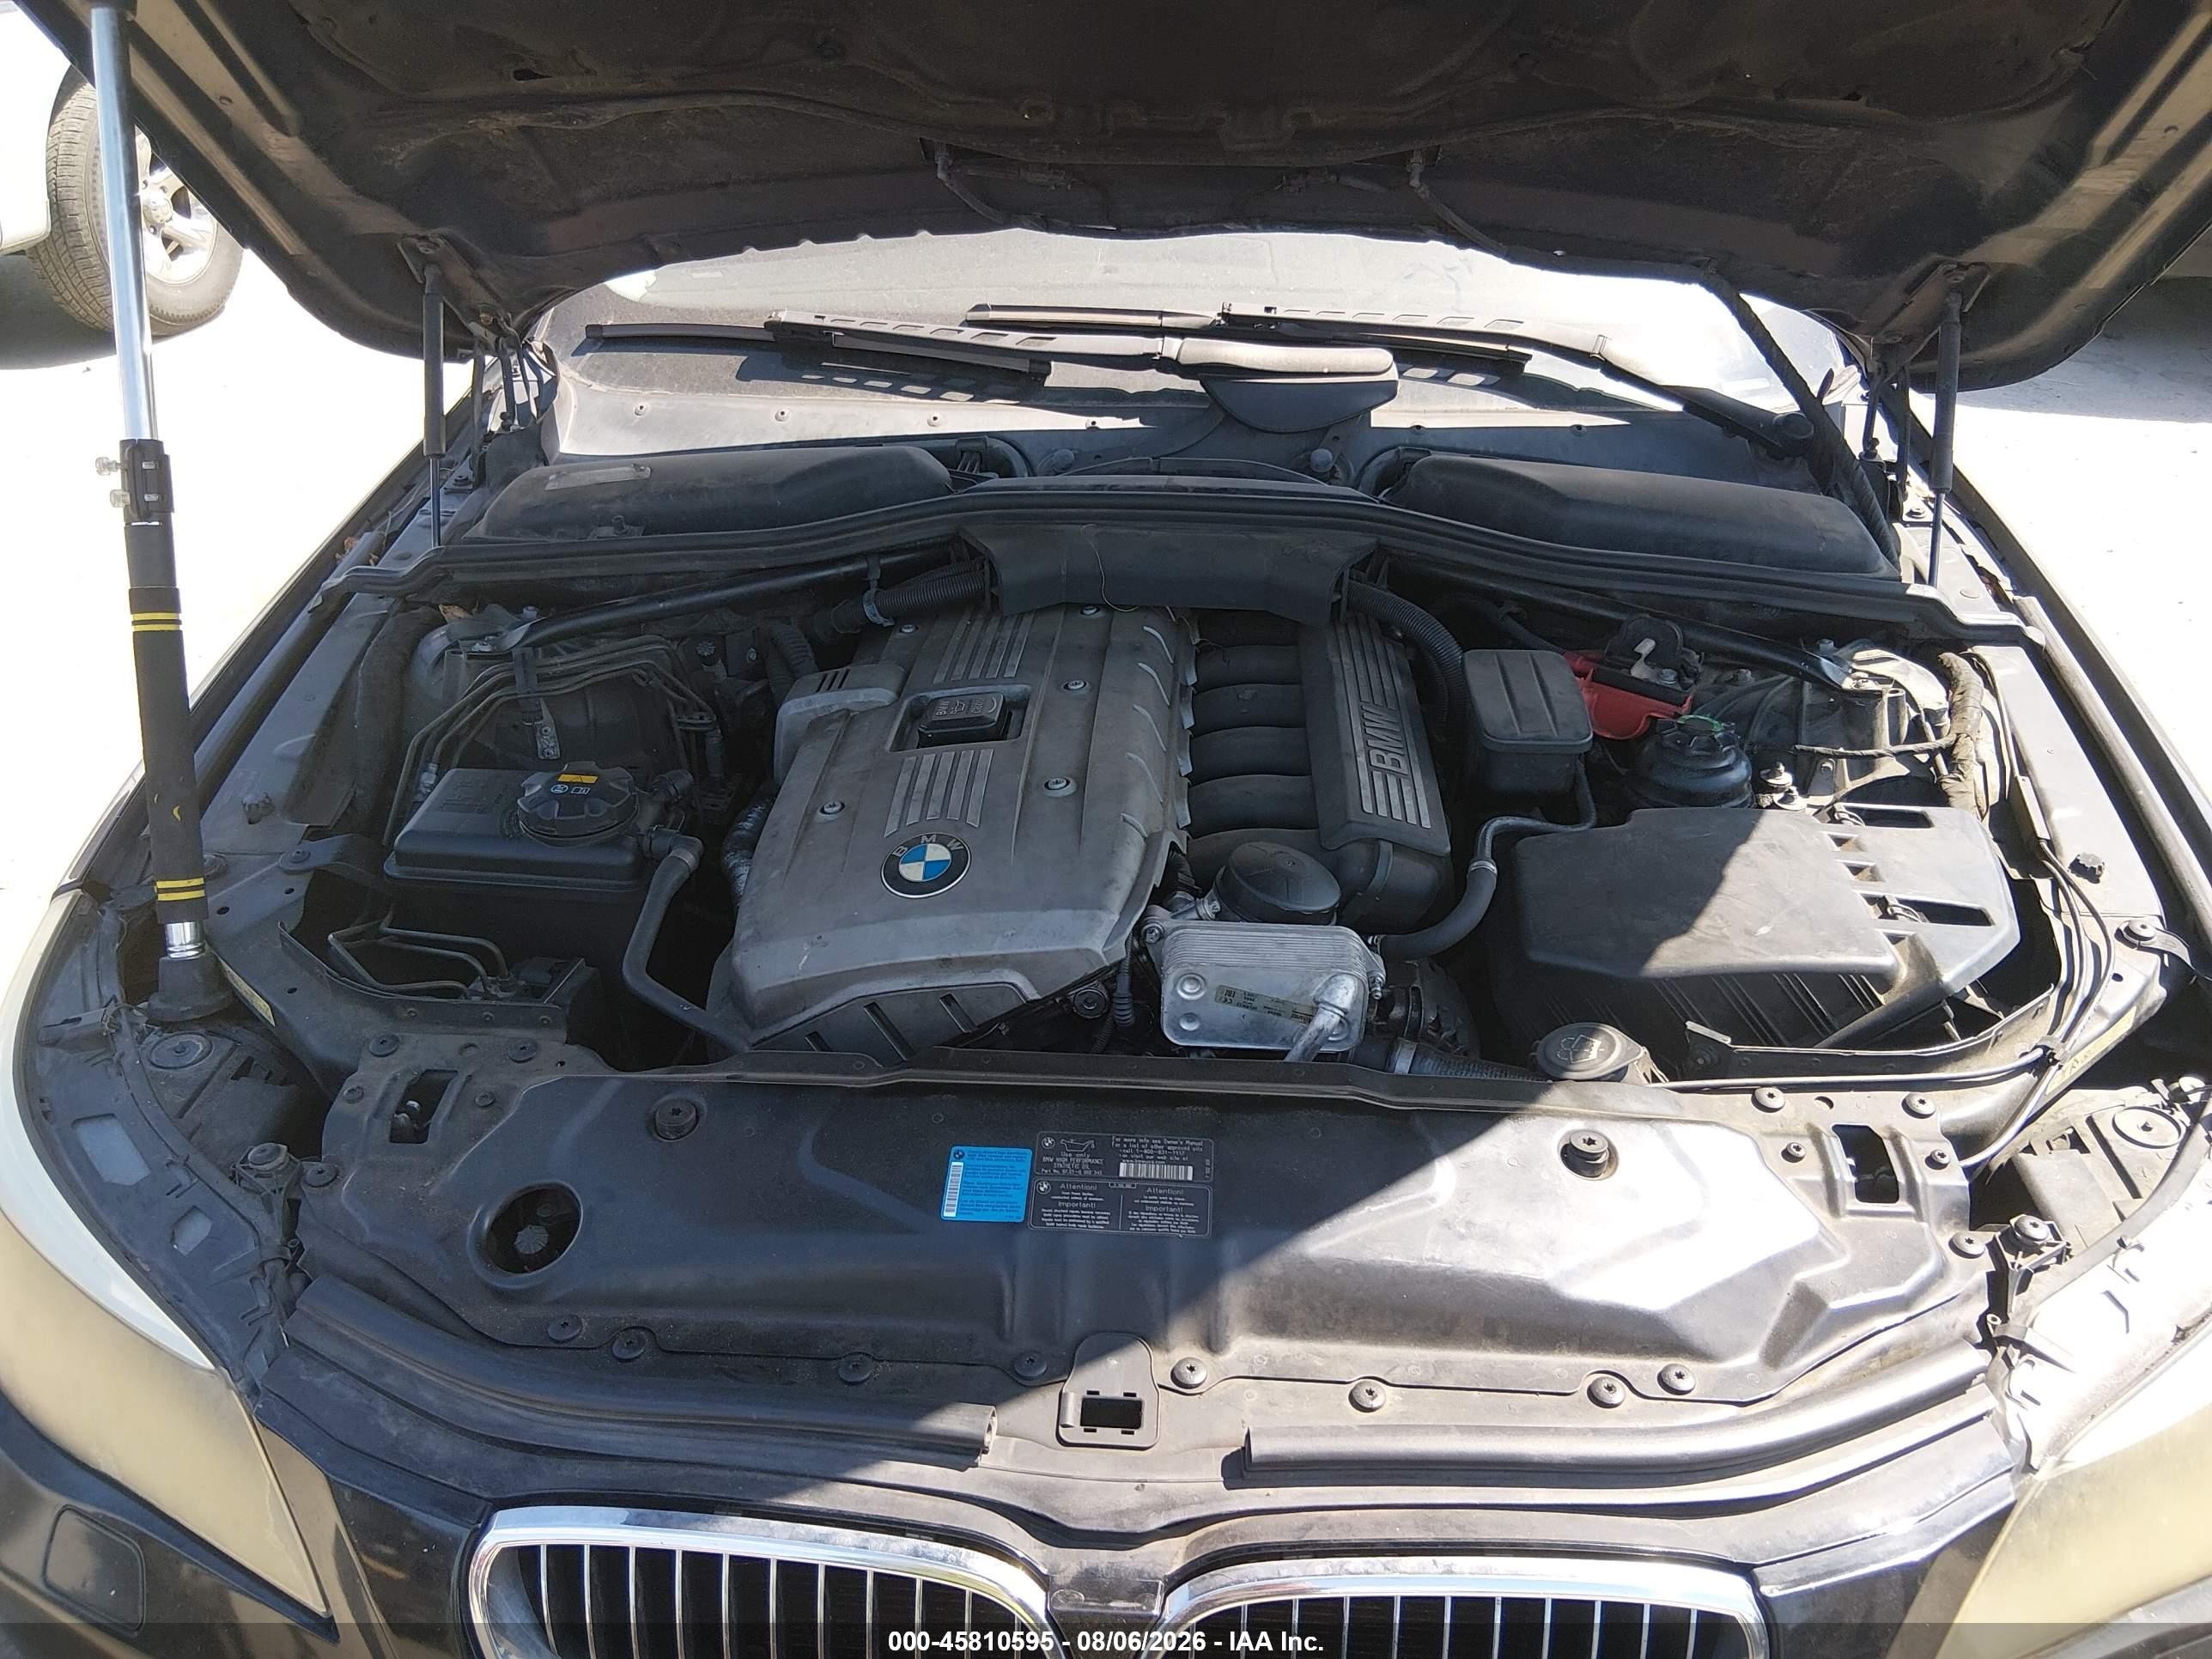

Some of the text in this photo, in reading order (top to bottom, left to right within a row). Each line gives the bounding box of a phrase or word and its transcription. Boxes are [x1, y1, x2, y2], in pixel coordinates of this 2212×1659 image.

[1361, 705, 1409, 775] BMW
[892, 834, 964, 858] BMW
[1146, 1187, 1184, 1195] Attention!
[1145, 1205, 1183, 1213] Important!
